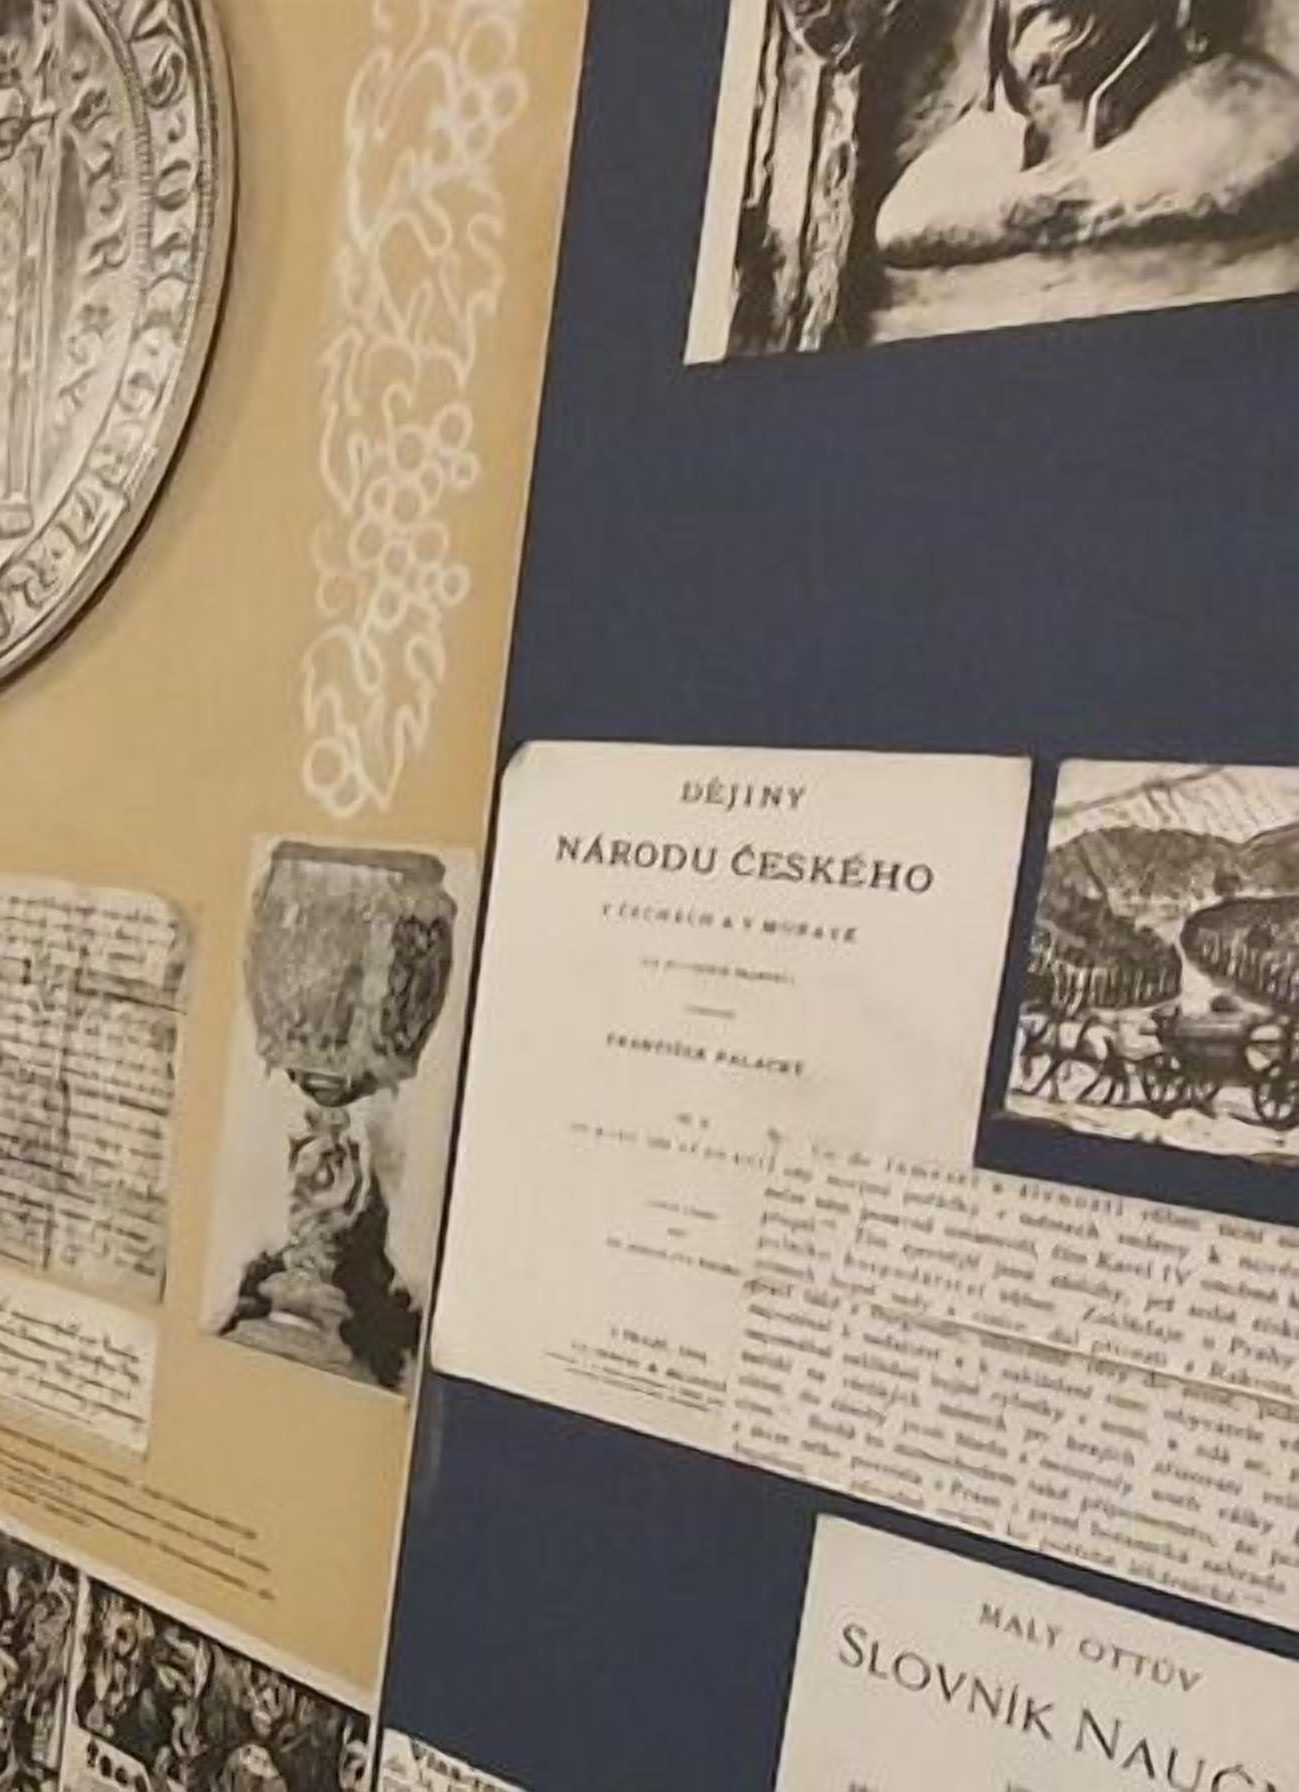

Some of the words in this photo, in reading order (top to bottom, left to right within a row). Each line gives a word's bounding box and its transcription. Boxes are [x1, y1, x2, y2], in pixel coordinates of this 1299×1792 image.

[555, 832, 718, 877] NÁRODU
[731, 842, 936, 896] ČESKÉHO
[837, 1622, 1054, 1741] SLOVNÍK
